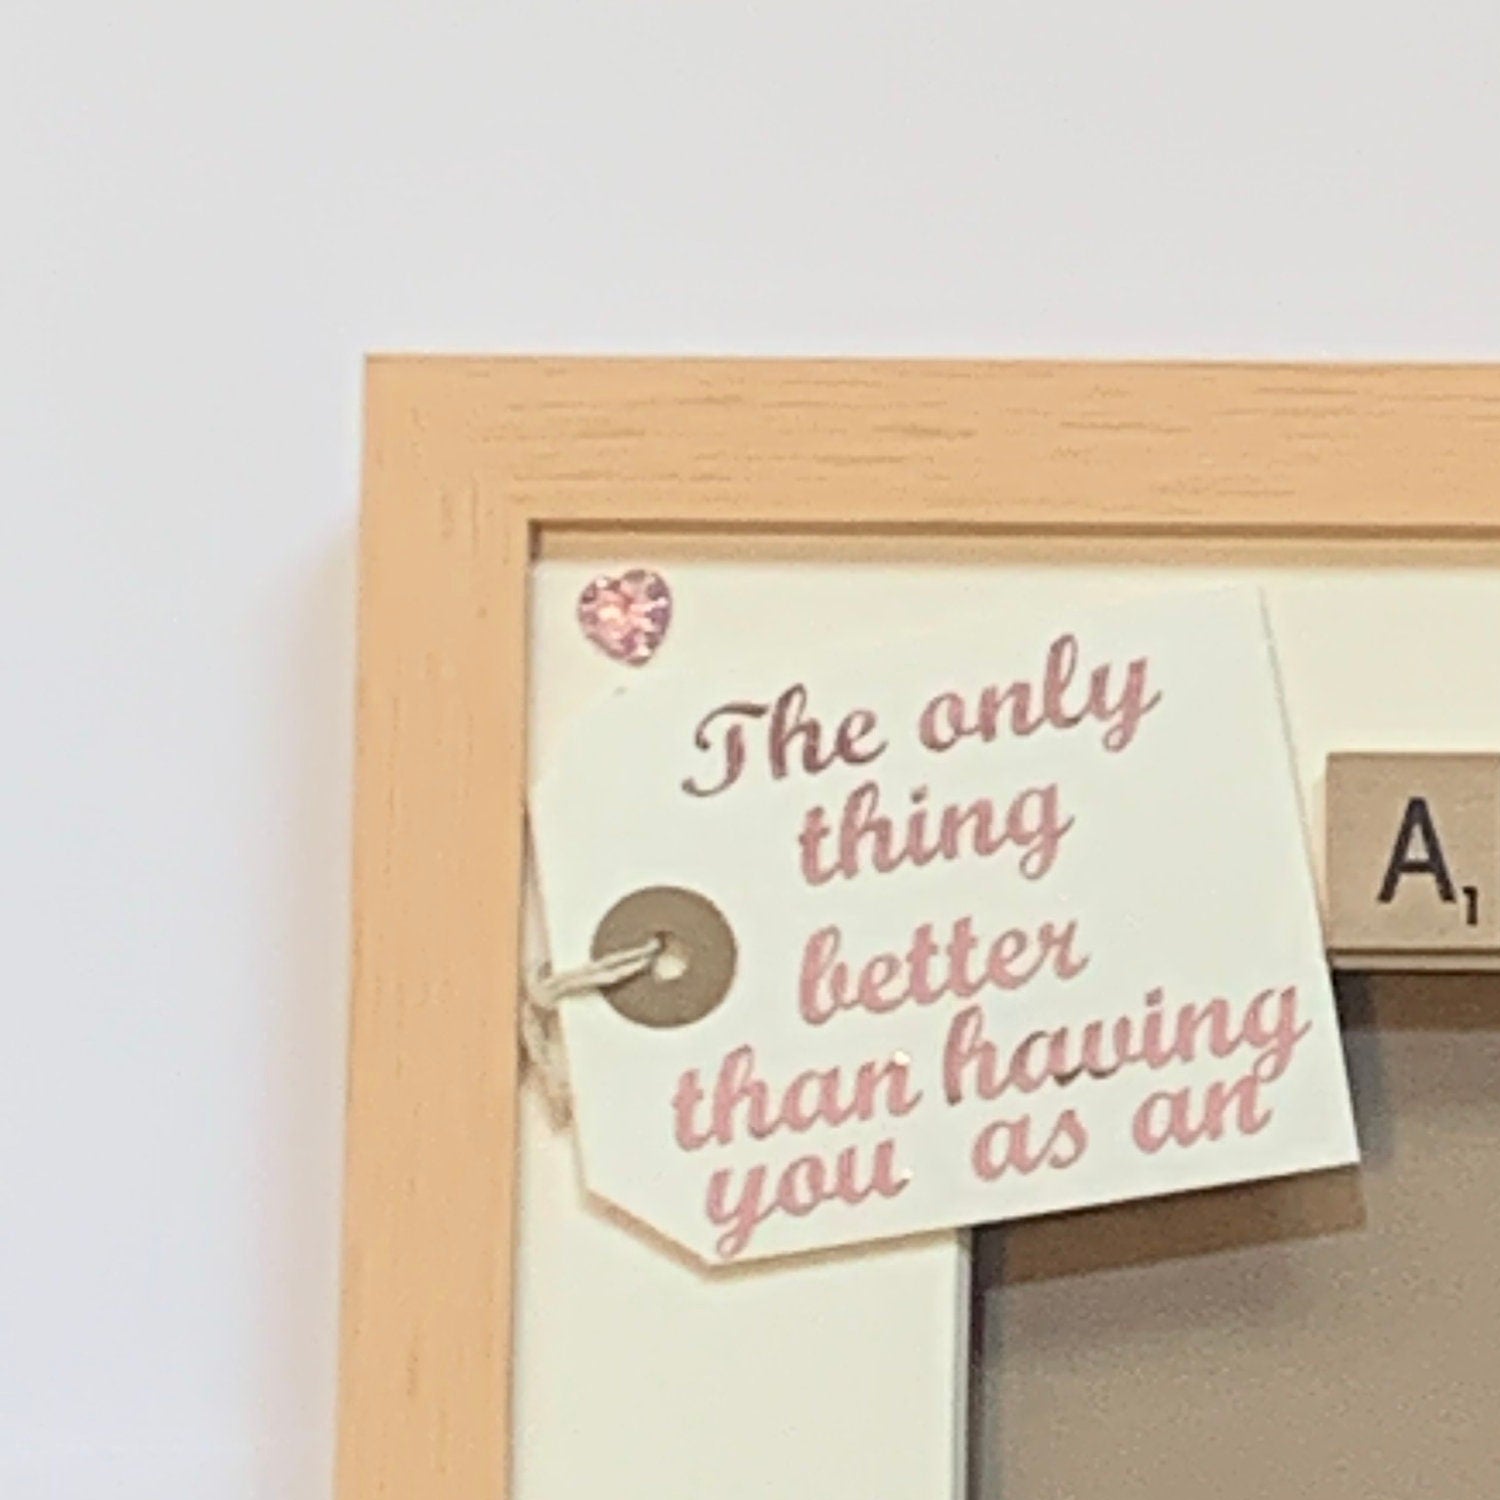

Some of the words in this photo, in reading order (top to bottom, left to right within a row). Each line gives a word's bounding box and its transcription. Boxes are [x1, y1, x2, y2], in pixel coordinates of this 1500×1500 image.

[681, 684, 888, 799] The
[917, 633, 1163, 753] only
[798, 779, 1076, 886] thing
[798, 915, 1088, 1026] better
[672, 1044, 923, 1151] than
[942, 981, 1313, 1108] having
[705, 1137, 910, 1260] you
[972, 1106, 1089, 1183] as
[1132, 1072, 1274, 1153] an
